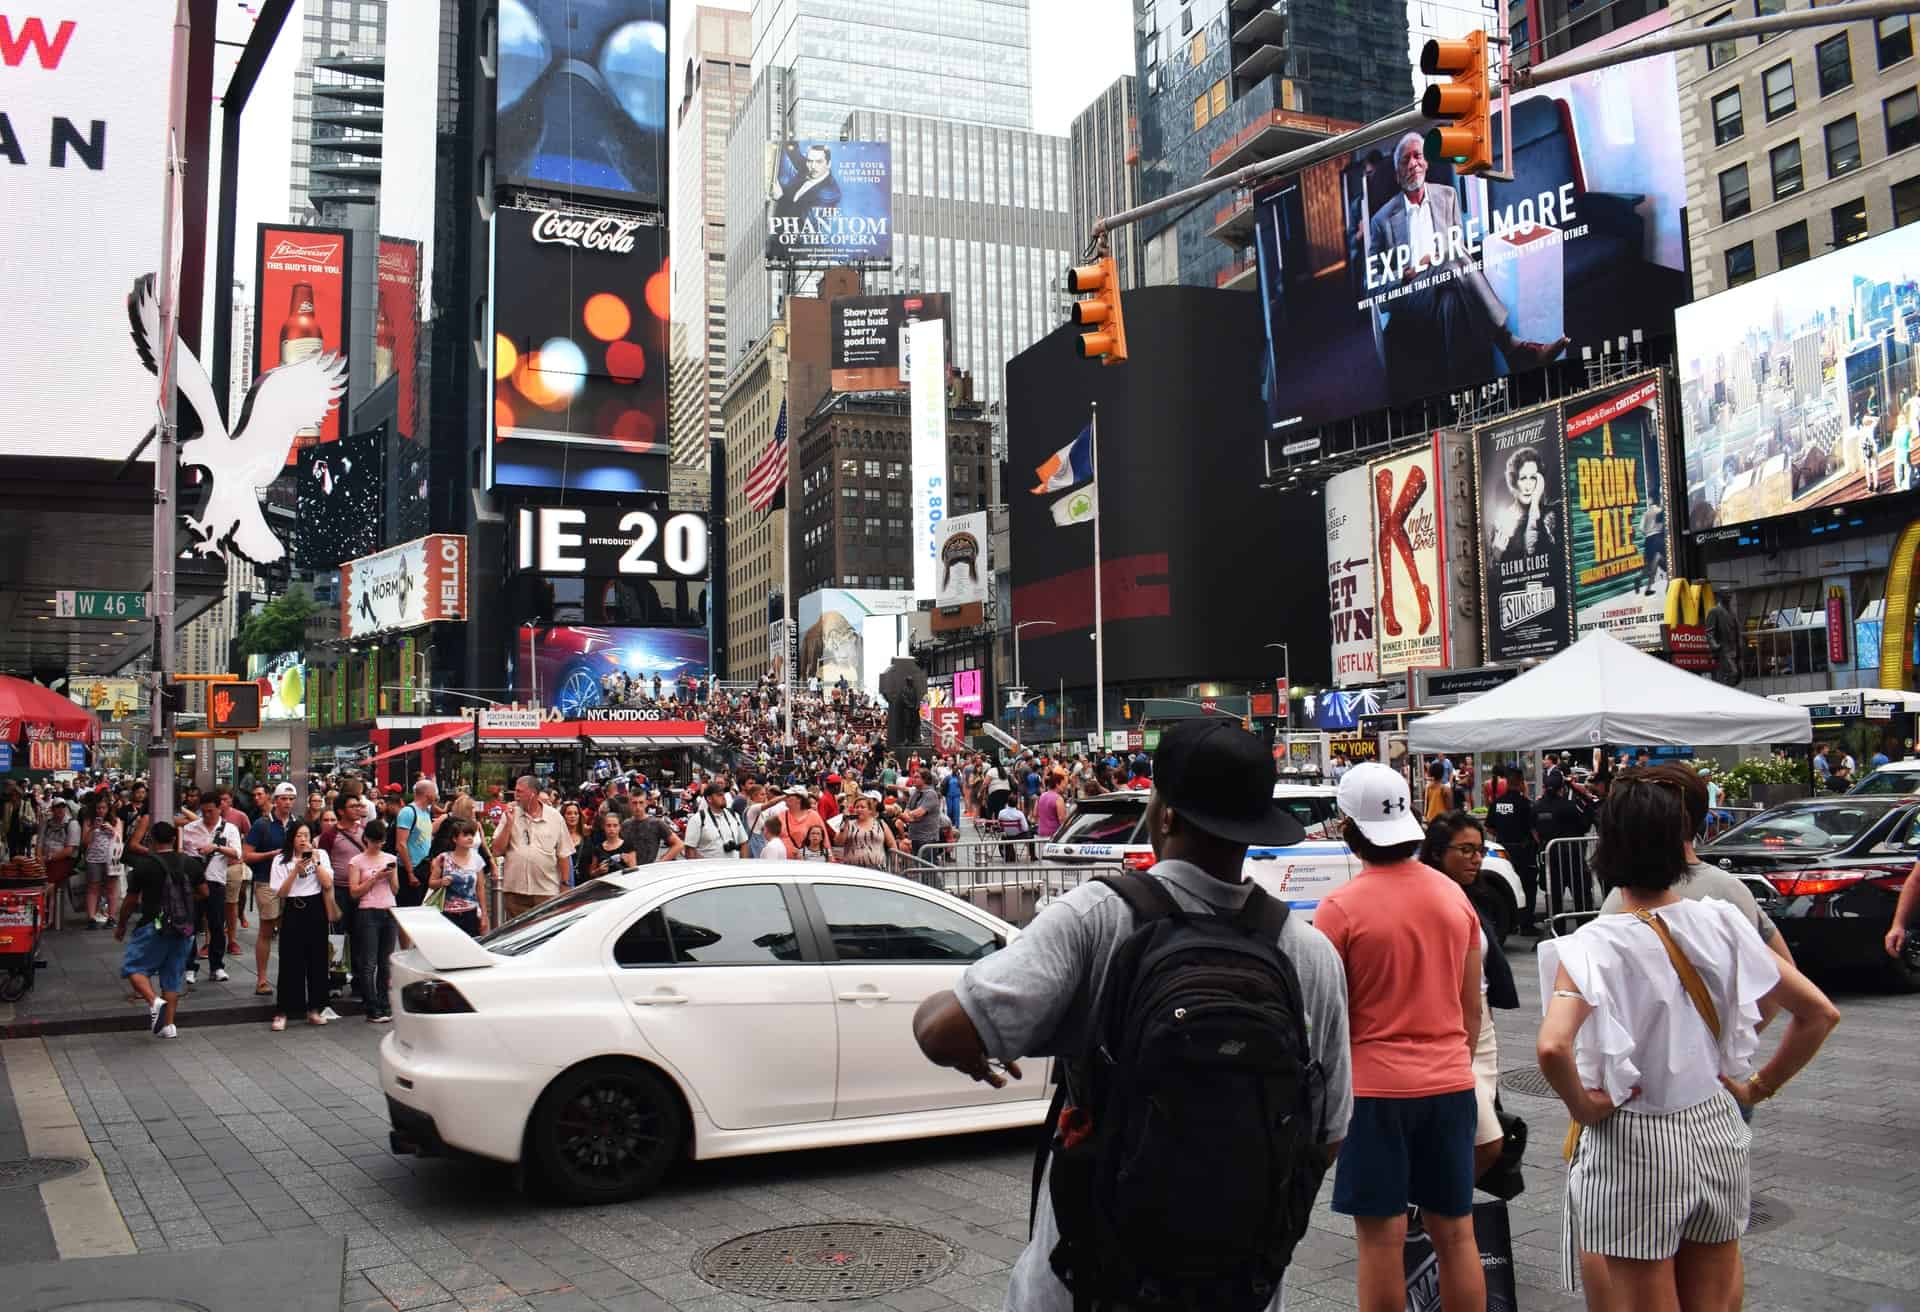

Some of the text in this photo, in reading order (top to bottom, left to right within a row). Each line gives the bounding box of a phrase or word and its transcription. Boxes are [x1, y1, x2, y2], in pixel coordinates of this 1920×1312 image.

[814, 208, 842, 217] THE
[532, 210, 640, 253] Coca-Cola
[768, 216, 889, 235] PHANTOM
[779, 234, 877, 246] OF THE OPERA
[1366, 182, 1577, 290] EXPLORE MORE
[267, 262, 284, 271] THIS
[308, 265, 323, 273] FOR
[1375, 291, 1388, 303] THE
[1388, 284, 1413, 301] AIRLINE
[1415, 279, 1431, 292] THAT
[1432, 272, 1451, 286] FLIES
[1564, 225, 1589, 241] OTHER
[843, 308, 889, 318] Show your
[843, 317, 889, 327] taste buds
[851, 327, 877, 337] berry
[843, 336, 887, 348] good time
[1602, 421, 1614, 456] A
[1577, 456, 1639, 511] BRONX
[618, 511, 708, 576] 20
[1588, 505, 1637, 563] TALE
[1526, 553, 1550, 572] CLOSE
[1330, 575, 1357, 612] ET
[79, 594, 96, 615] W
[103, 595, 127, 615] 46
[1649, 612, 1664, 621] STOR
[1337, 653, 1374, 674] NETFLIX
[587, 708, 660, 722] NYC HOTDOGS
[941, 711, 960, 749] tkts
[1349, 741, 1376, 757] YORK
[1080, 846, 1112, 855] POLICE
[1480, 1256, 1508, 1266] eebok
